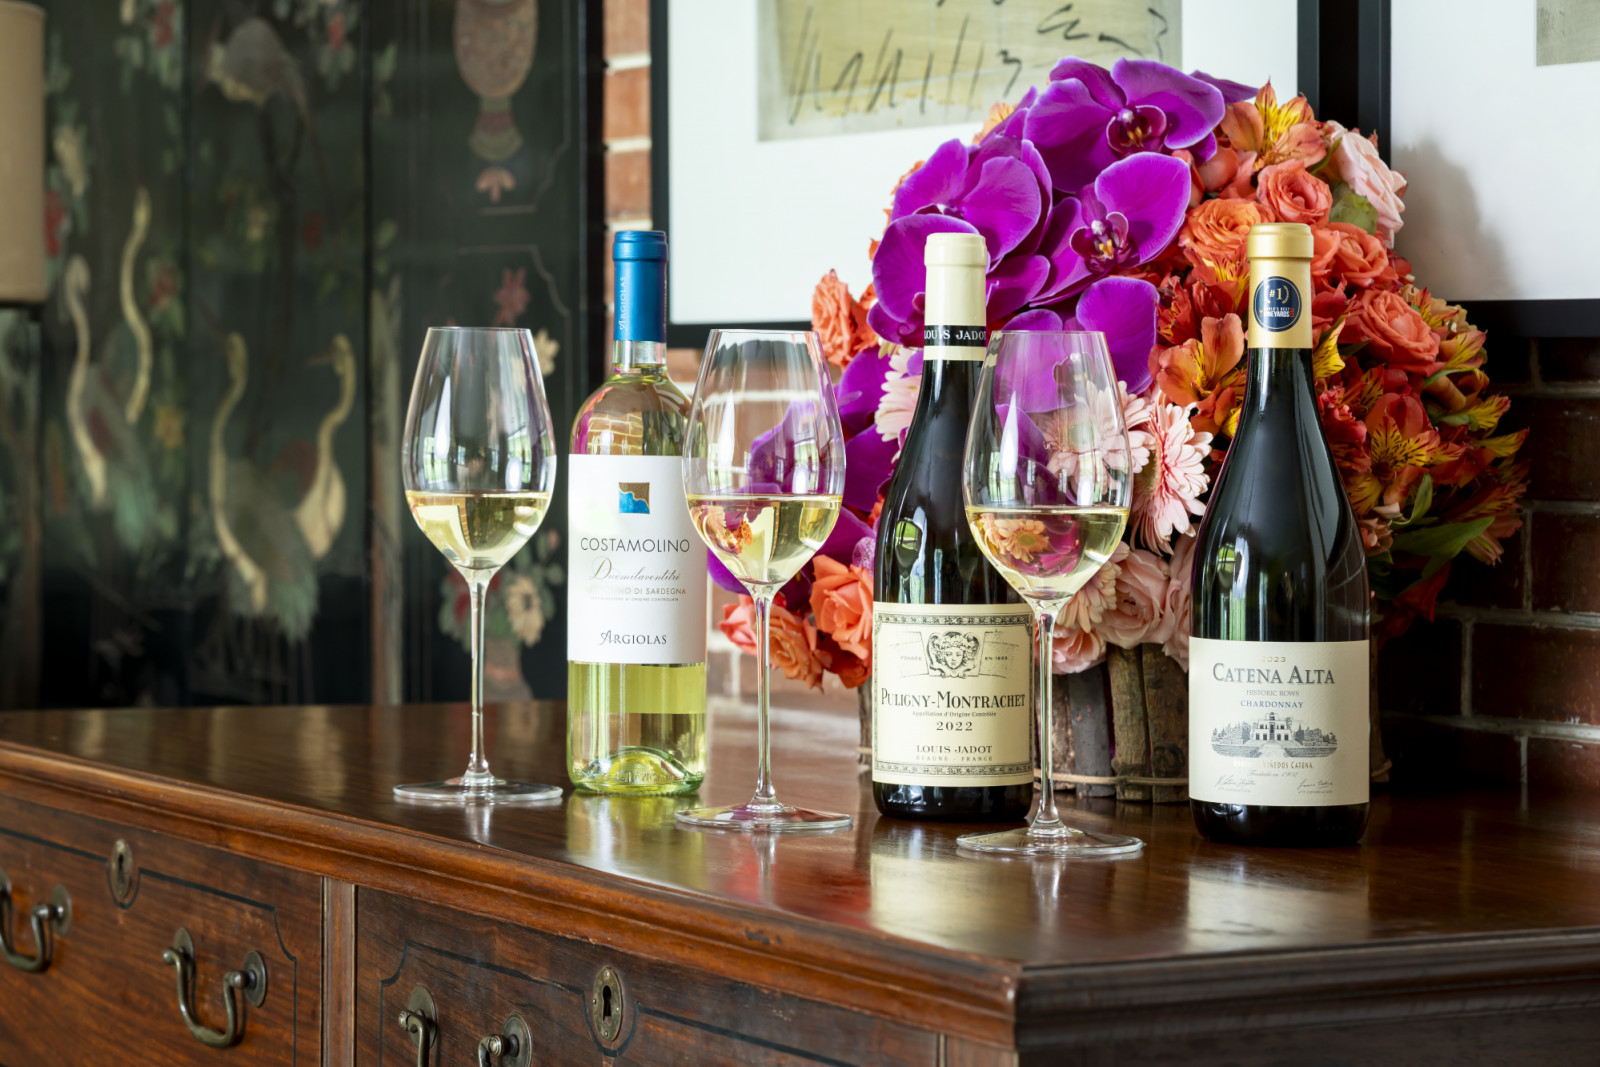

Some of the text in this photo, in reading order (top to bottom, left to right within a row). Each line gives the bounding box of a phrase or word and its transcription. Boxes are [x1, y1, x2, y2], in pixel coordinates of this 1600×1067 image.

[1269, 287, 1282, 300] #1
[618, 276, 627, 331] ARGIOLAS
[580, 537, 690, 553] COSTAMOLINO
[634, 587, 643, 595] DI
[645, 587, 687, 595] SARDEGNA
[599, 630, 667, 646] ARGIOLAS
[1212, 662, 1336, 685] CATENA ALTA
[881, 687, 1026, 709] PULIGNY-MONTRACHET
[1246, 689, 1278, 697] HISTORIC
[1240, 700, 1304, 709] CHARDONNAY
[936, 721, 973, 732] 2022
[916, 745, 993, 754] LOUIS JADOT
[1290, 761, 1314, 769] CATENA
